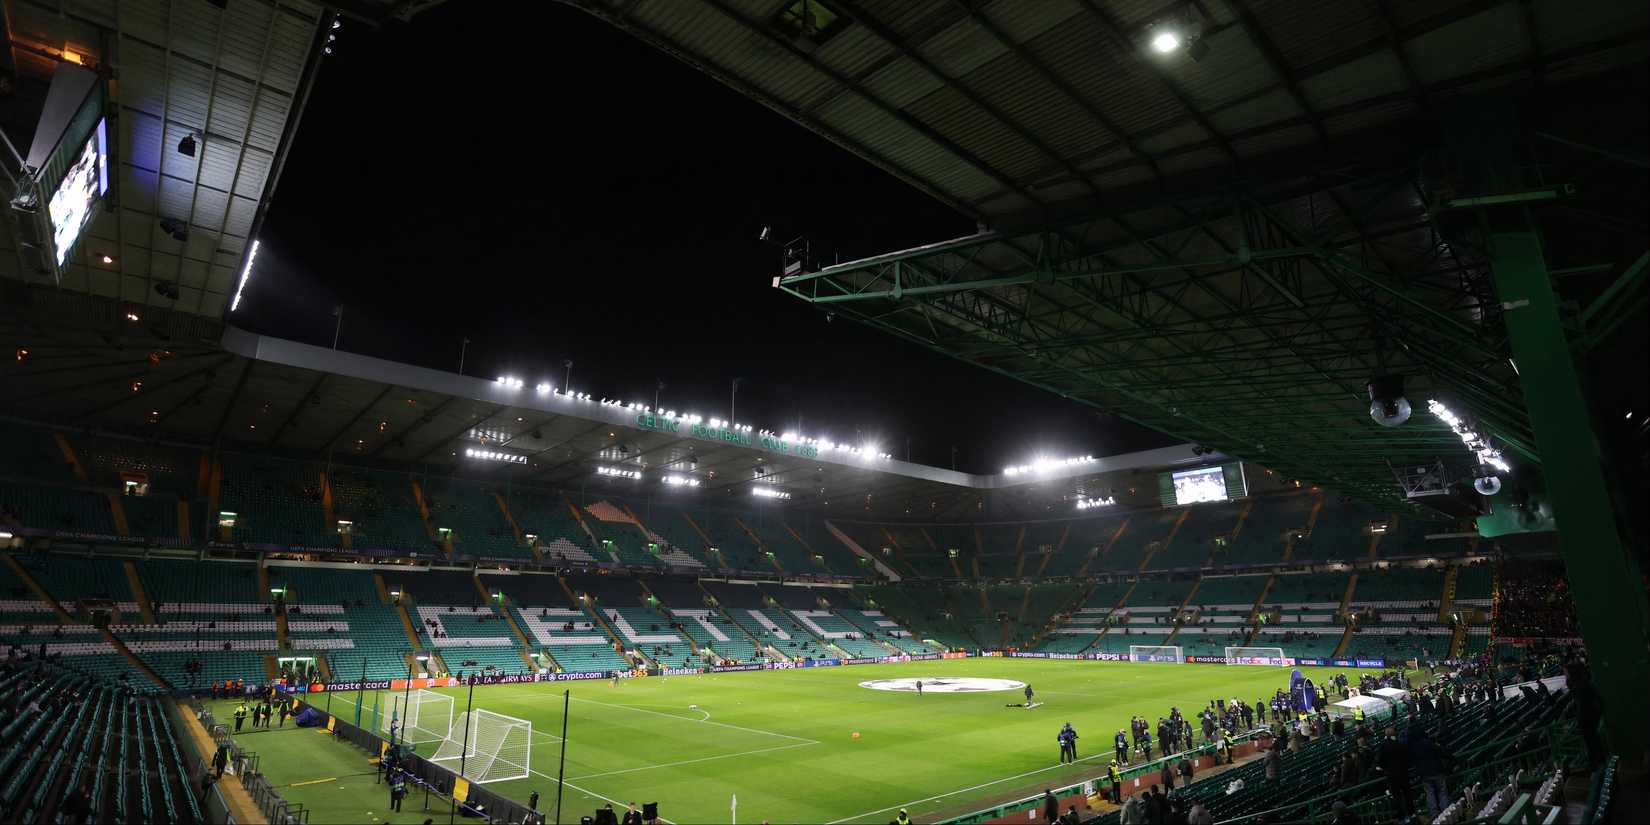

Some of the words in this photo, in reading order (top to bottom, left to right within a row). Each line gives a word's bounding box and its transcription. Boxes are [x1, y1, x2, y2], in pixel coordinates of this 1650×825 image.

[634, 413, 680, 433] CELTIC
[690, 422, 753, 446] FOOTBALL
[760, 434, 788, 452] CLUB
[1096, 653, 1120, 661] PEPSI
[773, 661, 796, 670] PEPSI
[617, 669, 649, 678] bet365
[662, 666, 698, 675] Heineken
[558, 671, 602, 681] crypto.com
